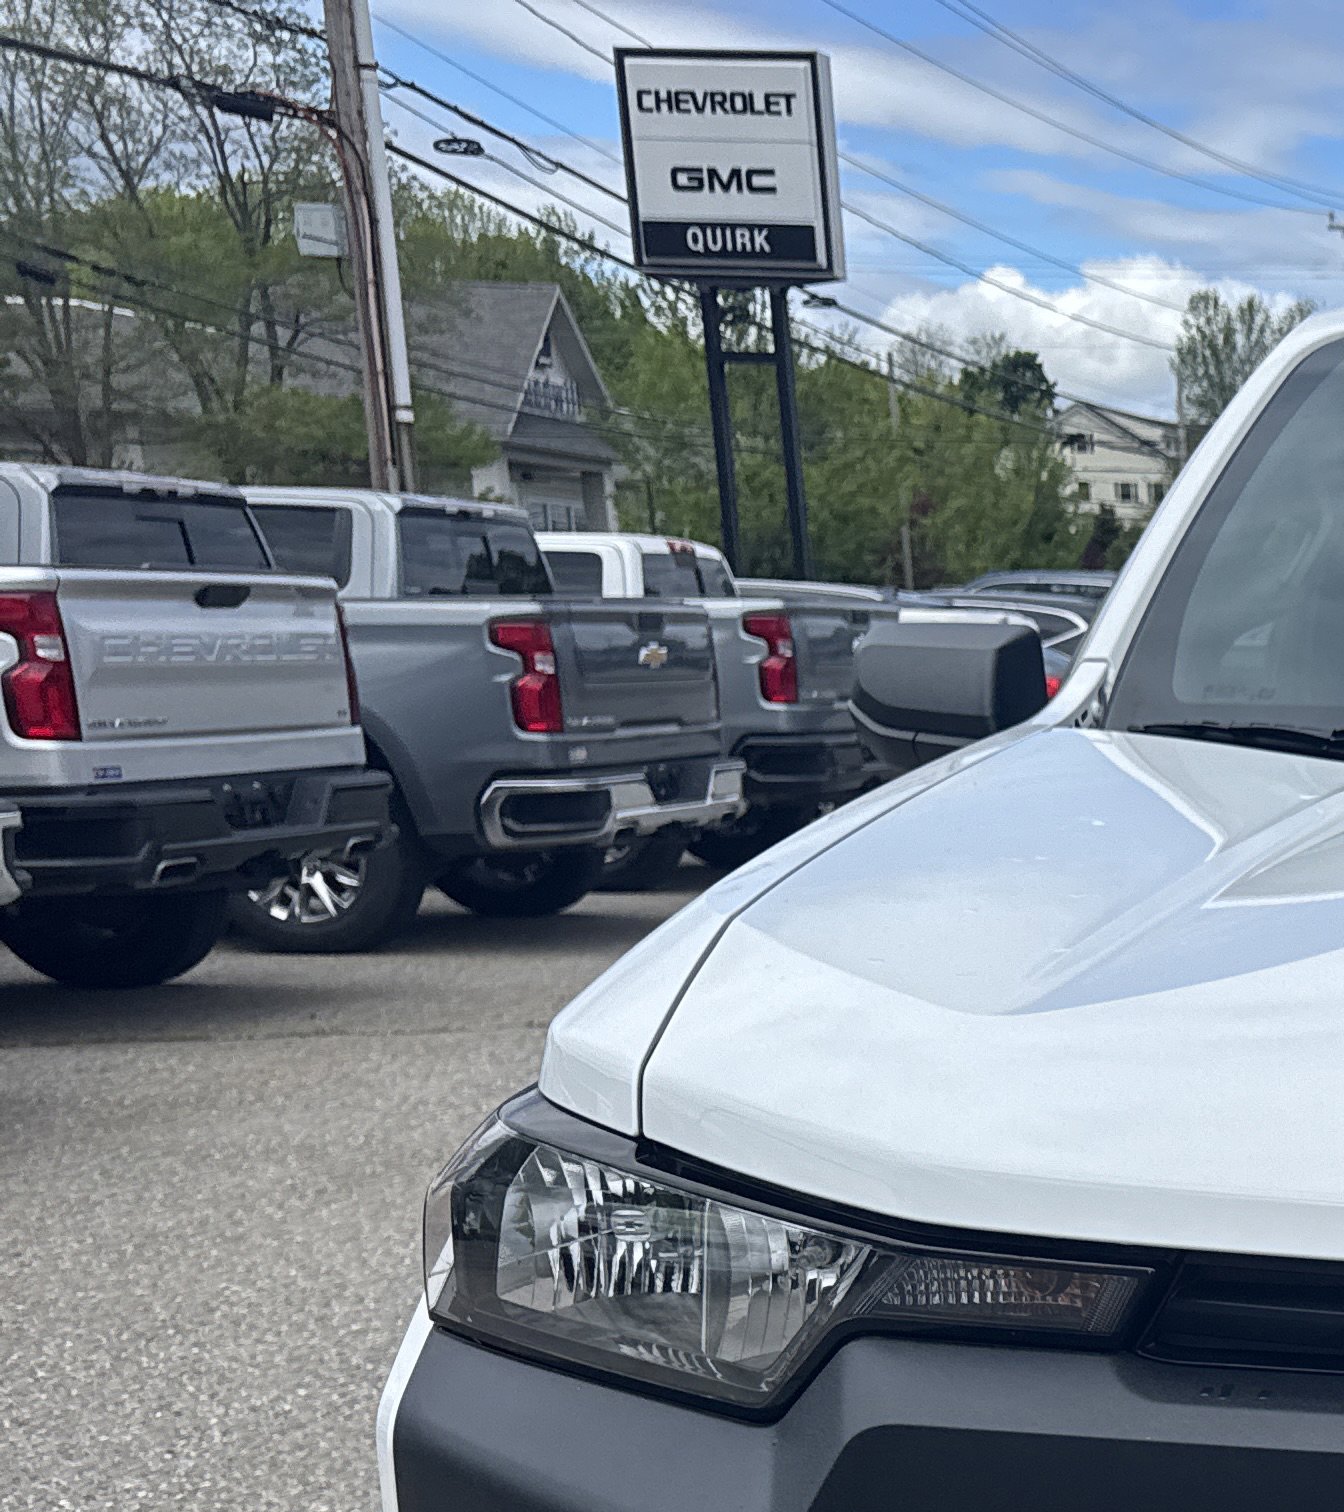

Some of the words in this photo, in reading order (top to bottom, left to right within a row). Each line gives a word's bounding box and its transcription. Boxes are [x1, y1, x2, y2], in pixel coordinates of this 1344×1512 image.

[636, 89, 796, 116] CHEVROLET
[670, 166, 777, 194] GMC
[686, 225, 771, 253] QUIRK
